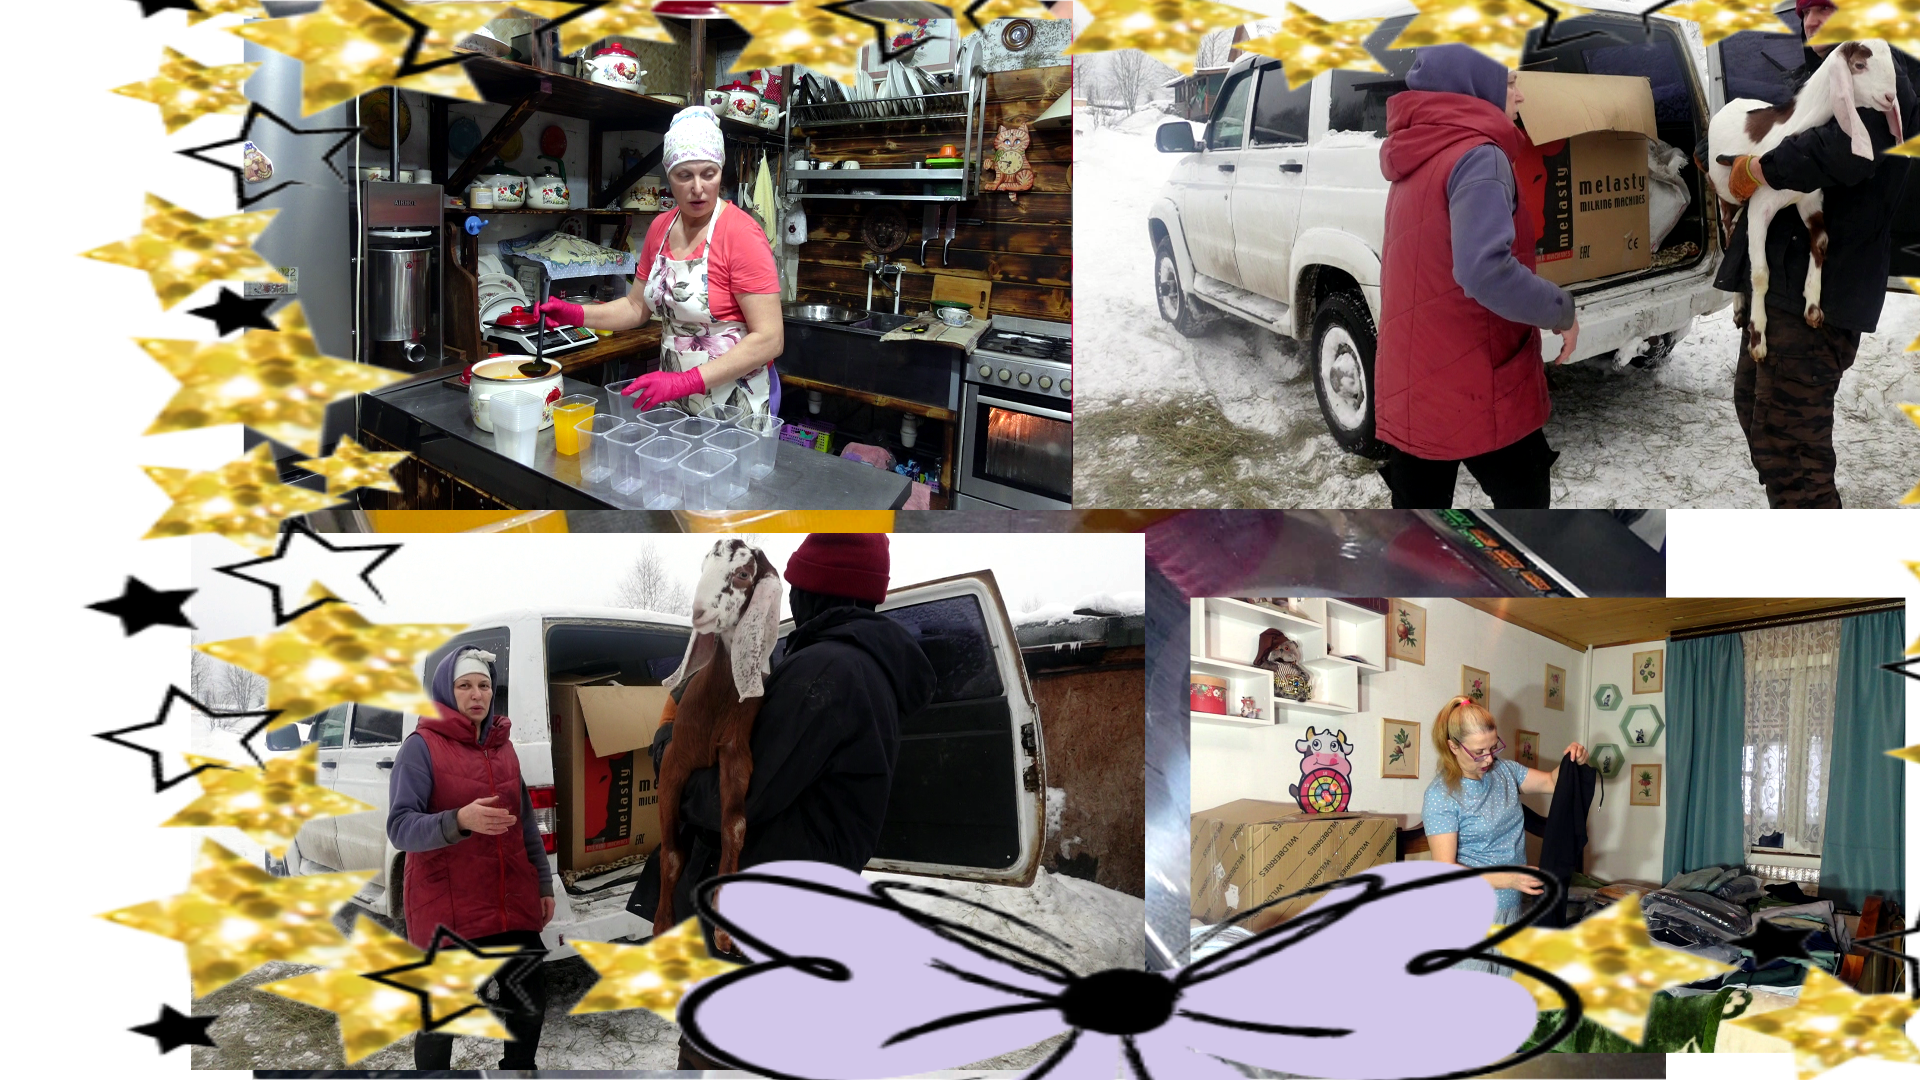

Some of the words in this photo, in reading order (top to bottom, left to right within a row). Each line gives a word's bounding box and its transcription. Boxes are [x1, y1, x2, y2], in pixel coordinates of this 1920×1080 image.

[1579, 173, 1645, 195] melasty
[1580, 199, 1612, 212] MILKING
[1614, 195, 1646, 208] MACHINES
[1555, 167, 1569, 248] melasty
[618, 768, 630, 837] melasty
[638, 795, 658, 806] MILK
[1258, 835, 1299, 878] WILDBERRIES
[1339, 840, 1370, 878] WILDBERRIES
[1297, 859, 1332, 900] WILDBERR
